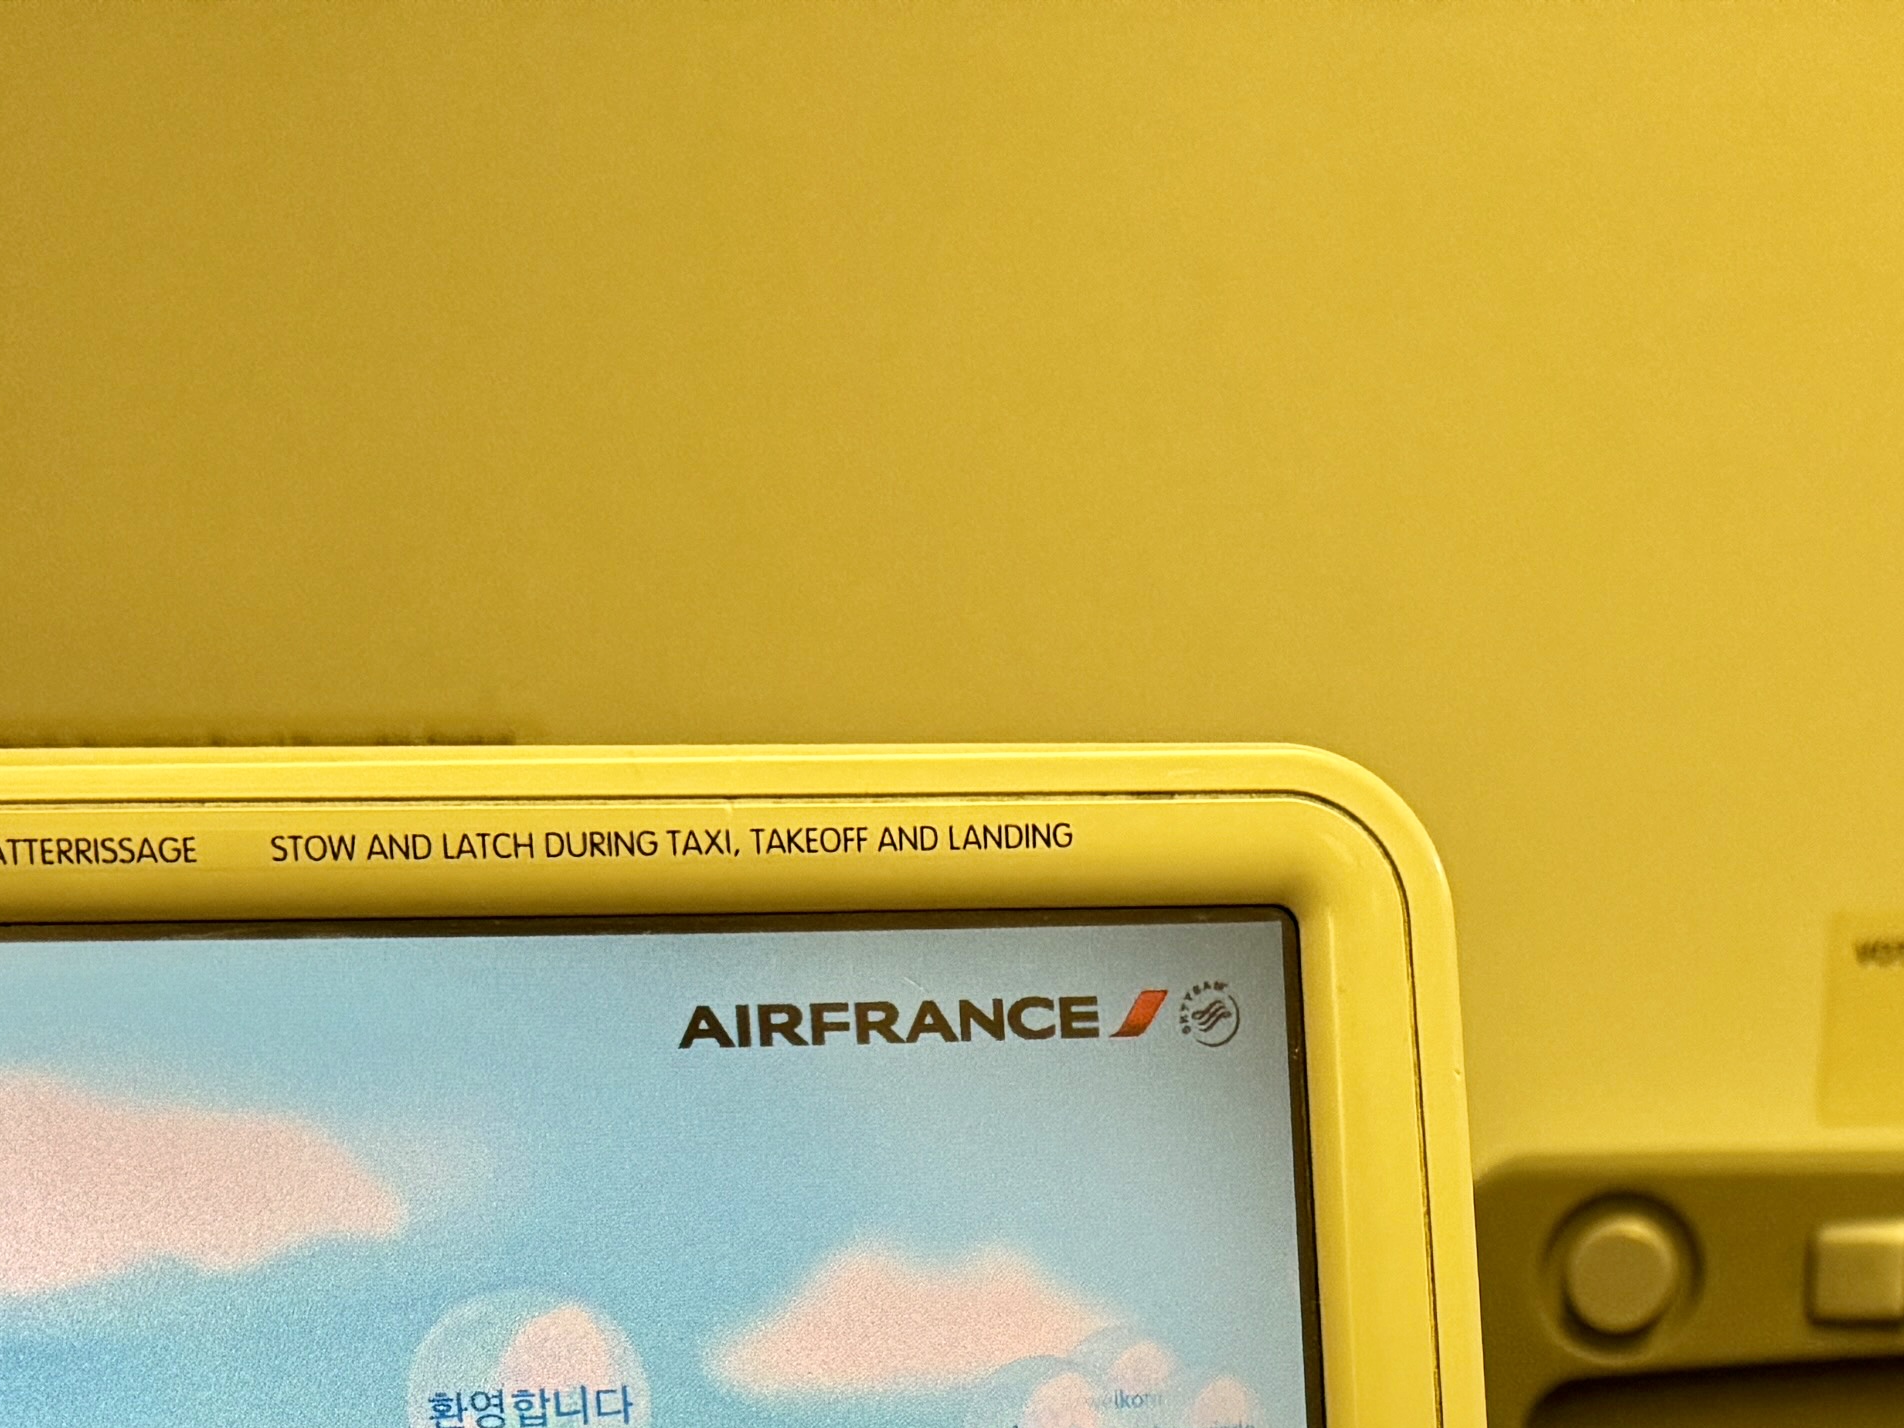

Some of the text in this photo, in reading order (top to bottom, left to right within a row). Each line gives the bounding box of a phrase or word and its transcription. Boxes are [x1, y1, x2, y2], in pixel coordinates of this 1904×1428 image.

[271, 822, 1074, 863] STOW AND LATCH DURING TAXI, TAKEOFF AND LANDING
[678, 995, 1100, 1050] AIRFRANCE
